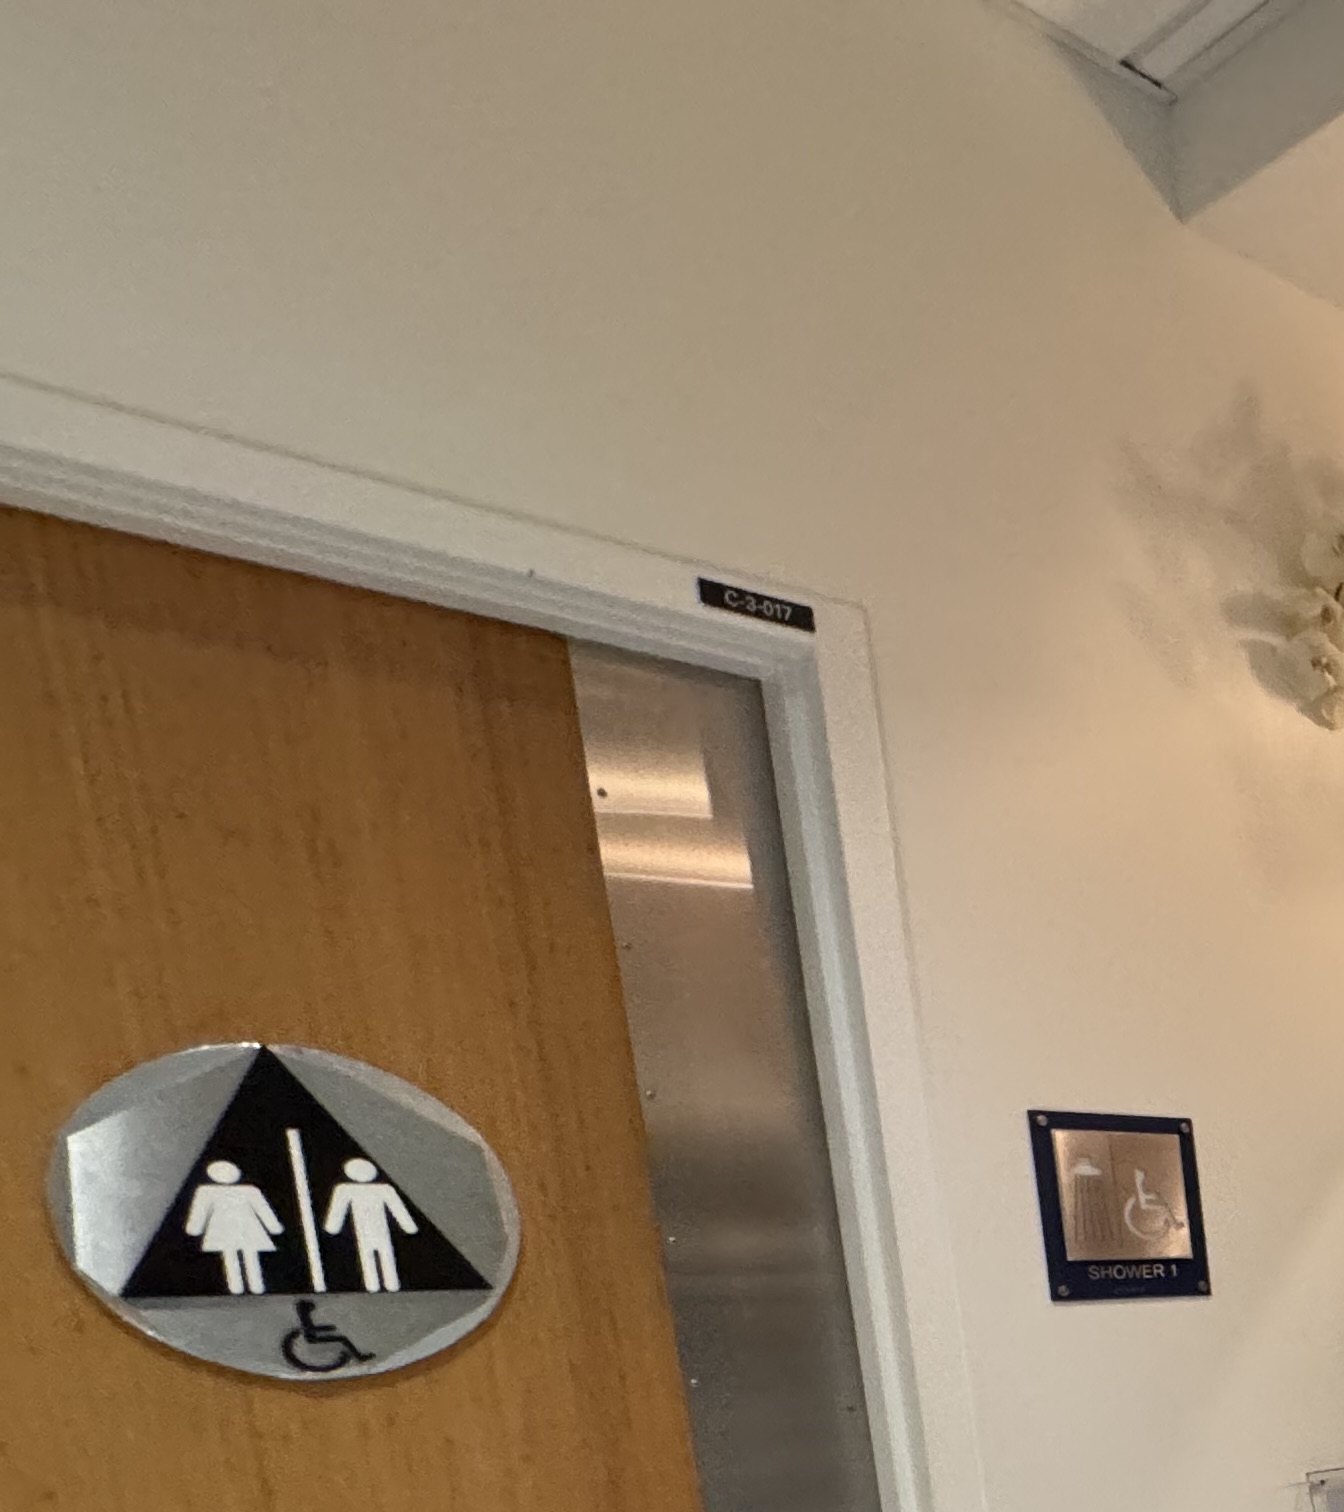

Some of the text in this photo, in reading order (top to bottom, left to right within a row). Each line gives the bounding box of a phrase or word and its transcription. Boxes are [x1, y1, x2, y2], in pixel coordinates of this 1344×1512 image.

[723, 589, 792, 621] C-3-017
[1087, 1263, 1178, 1280] SHOWER 1
